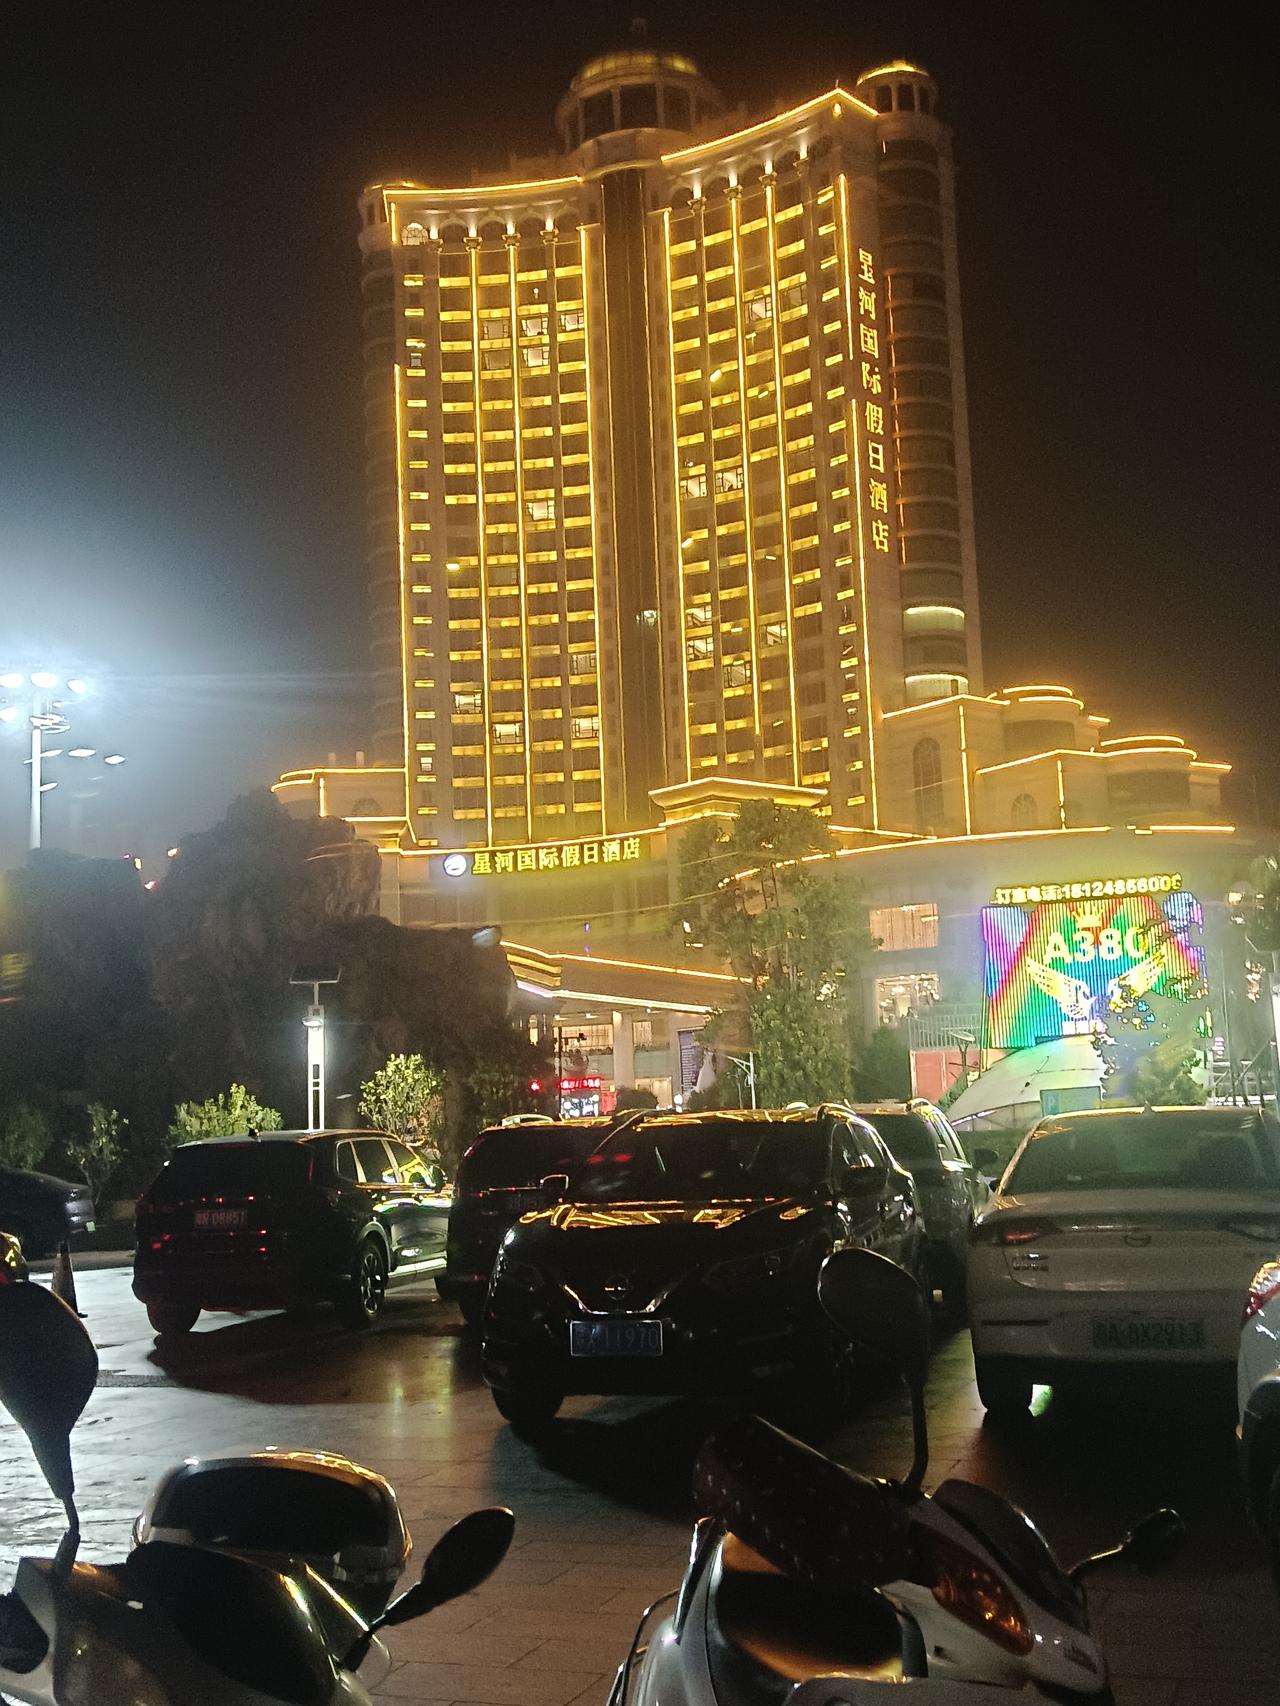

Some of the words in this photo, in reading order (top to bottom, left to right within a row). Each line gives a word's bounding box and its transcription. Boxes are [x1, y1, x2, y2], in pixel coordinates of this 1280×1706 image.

[472, 837, 641, 875] 星河国际假日酒店
